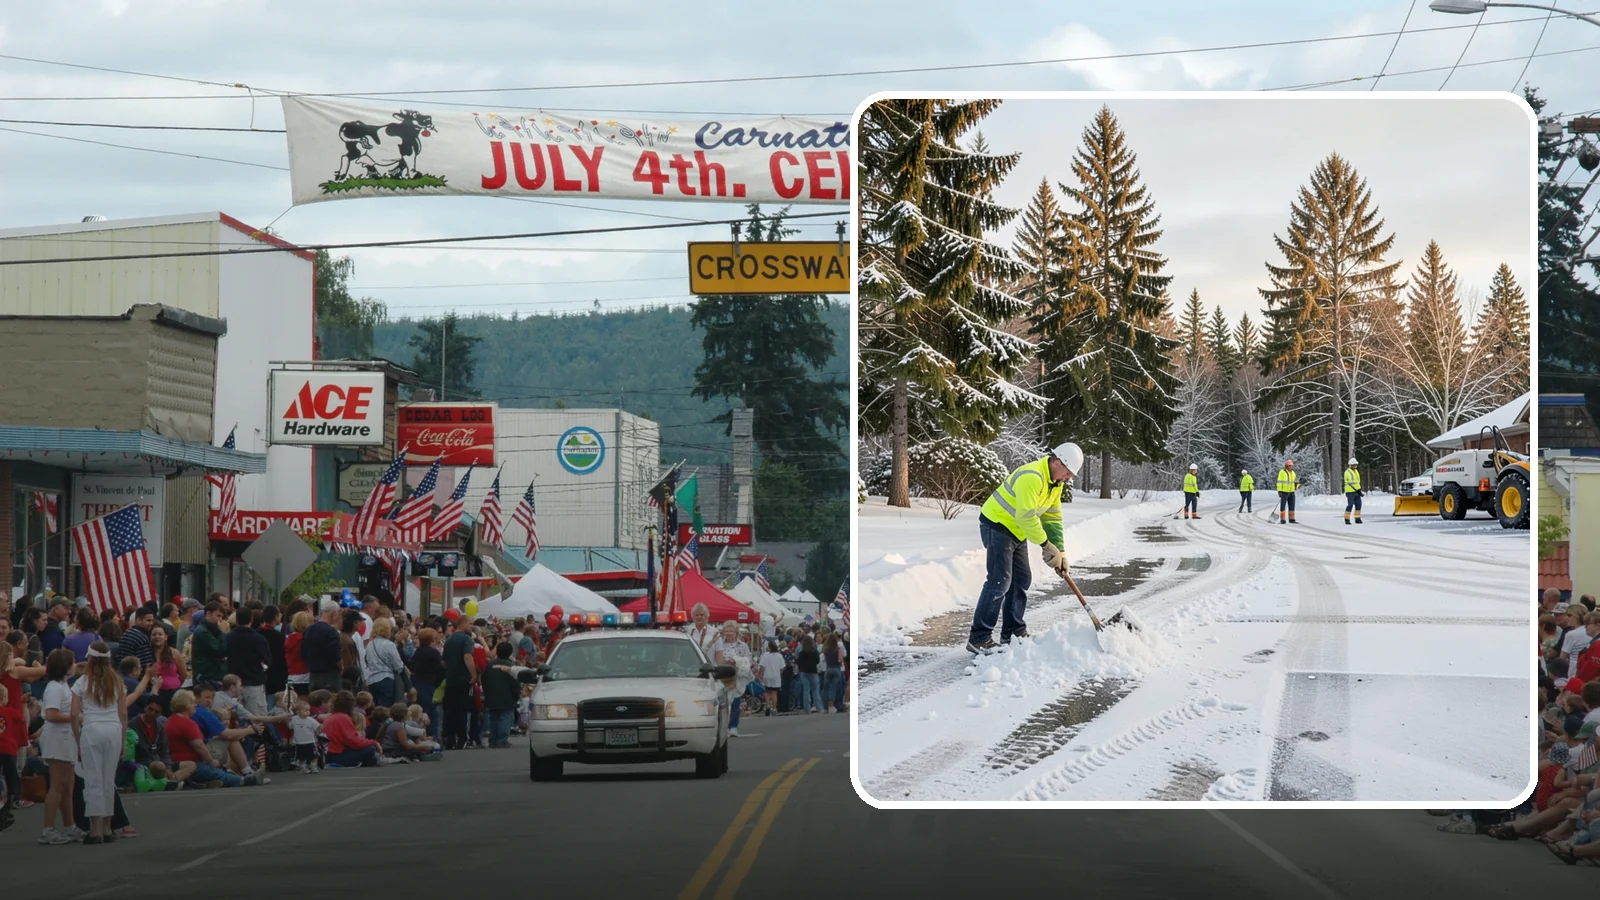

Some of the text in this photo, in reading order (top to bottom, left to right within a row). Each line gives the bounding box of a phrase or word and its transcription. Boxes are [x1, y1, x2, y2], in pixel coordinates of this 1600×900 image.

[481, 140, 605, 192] JULY
[632, 150, 746, 197] 4th.
[696, 254, 850, 280] CROSSWA
[282, 380, 373, 419] ACE
[405, 409, 485, 421] CEDAR LOG
[283, 421, 371, 436] Hardware
[416, 428, 477, 447] Coca-Cola
[353, 467, 386, 480] Simpl
[96, 485, 124, 495] Vincent
[126, 486, 136, 495] de
[137, 486, 155, 495] Paul
[212, 516, 331, 535] HARDARE
[688, 526, 742, 535] CRNATION
[699, 535, 730, 544] GLASS
